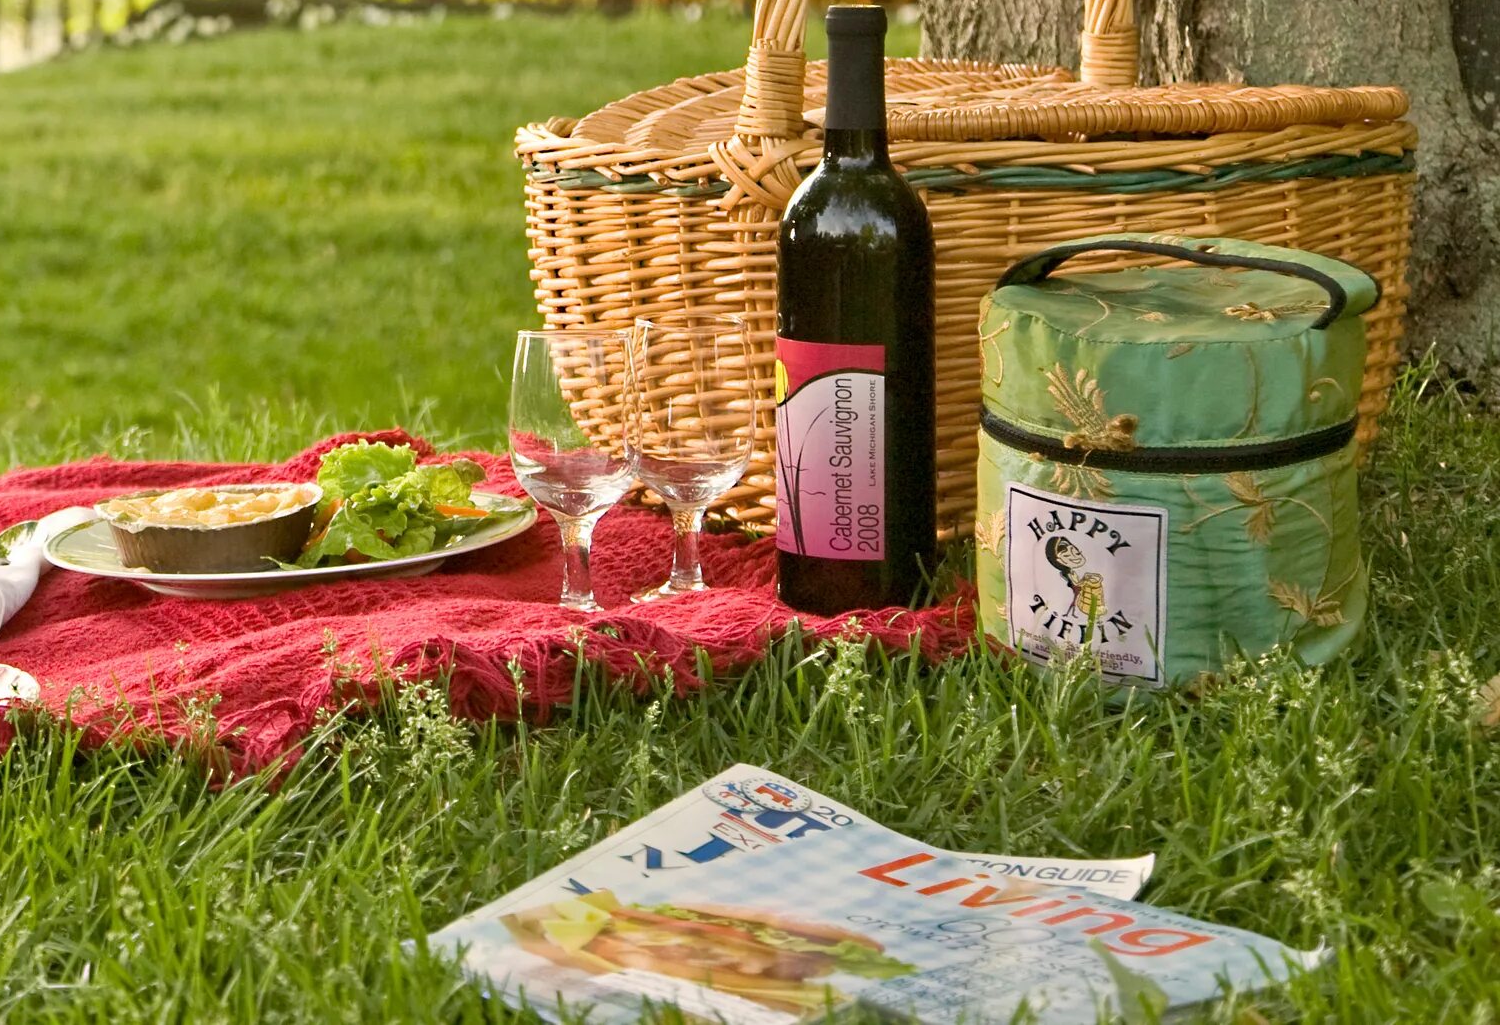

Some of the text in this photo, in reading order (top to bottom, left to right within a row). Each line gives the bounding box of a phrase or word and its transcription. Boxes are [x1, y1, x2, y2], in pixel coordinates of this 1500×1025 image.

[829, 378, 858, 552] Cabernet Sauvignon
[867, 379, 877, 487] LAKE MICHIGAN SHORE
[857, 504, 880, 553] 2008
[1027, 510, 1132, 557] HAPPY
[857, 852, 1218, 957] Living
[1035, 866, 1134, 884] GUIDE
